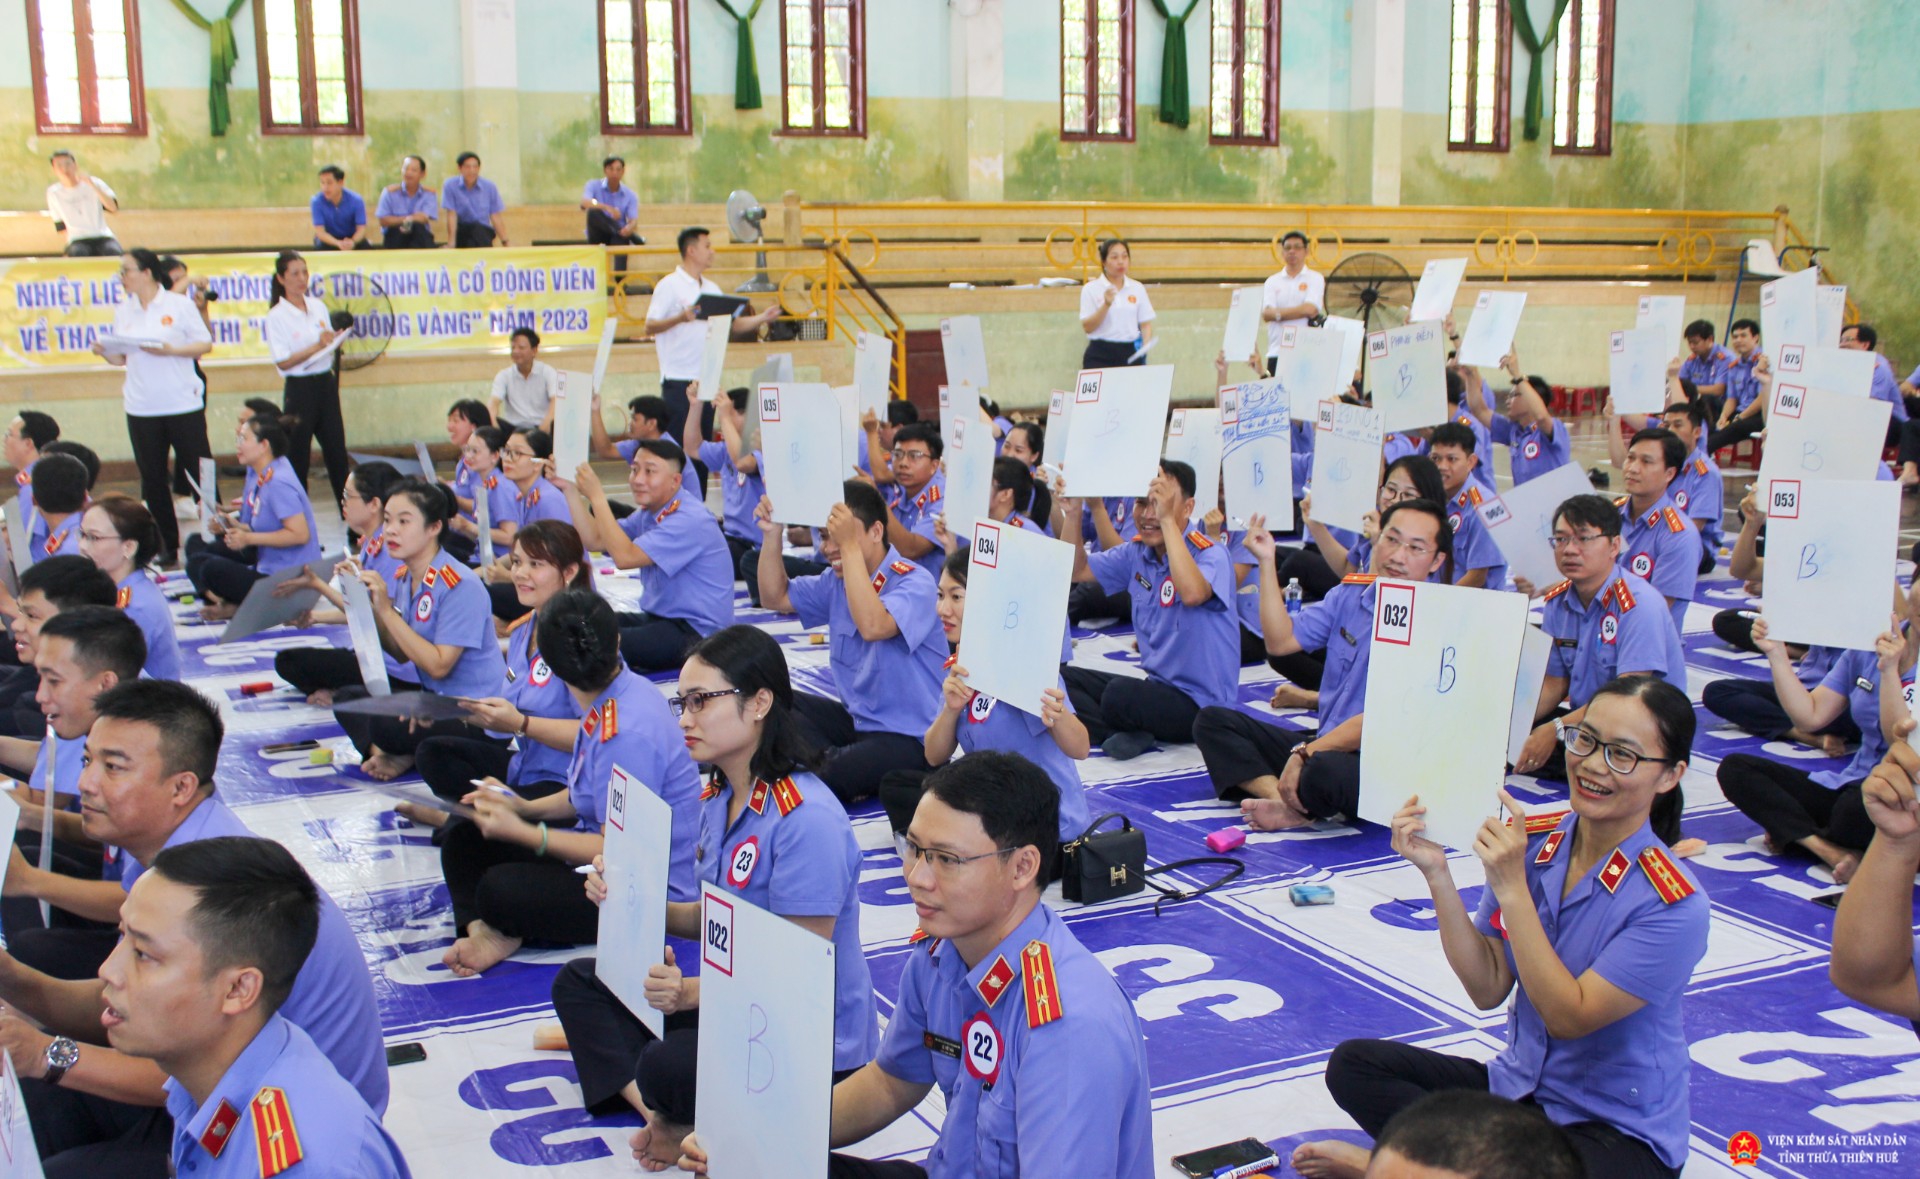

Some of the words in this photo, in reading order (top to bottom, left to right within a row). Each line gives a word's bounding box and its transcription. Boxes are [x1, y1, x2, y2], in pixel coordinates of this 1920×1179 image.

[370, 271, 419, 298] SINH
[425, 265, 452, 294] VÀ
[458, 260, 486, 294] CỔ
[490, 264, 545, 298] ĐỘNG
[551, 263, 596, 292] VIÊN
[16, 275, 83, 314] NHIỆT
[417, 307, 482, 336] VÀNG"
[489, 305, 535, 333] NĂM
[542, 308, 588, 331] 2023
[19, 317, 48, 352] VỀ
[1784, 353, 1801, 365] 075
[1082, 381, 1098, 395] 045
[763, 399, 777, 412] 035
[1781, 394, 1800, 409] 064
[1801, 441, 1824, 472] B
[1253, 462, 1264, 487] B
[1774, 492, 1795, 508] 053
[978, 537, 995, 556] 034
[1636, 558, 1648, 571] 65
[1797, 543, 1819, 582] B
[1163, 584, 1173, 598] 45
[1003, 601, 1019, 630] B
[1383, 603, 1409, 628] 032
[1604, 620, 1615, 634] 54
[536, 662, 549, 677] 25
[1437, 646, 1457, 694] B
[975, 697, 989, 712] 34
[612, 788, 623, 814] 023
[736, 850, 753, 872] 23
[708, 918, 728, 953] 022
[746, 1002, 775, 1095] B
[973, 1031, 993, 1062] 22
